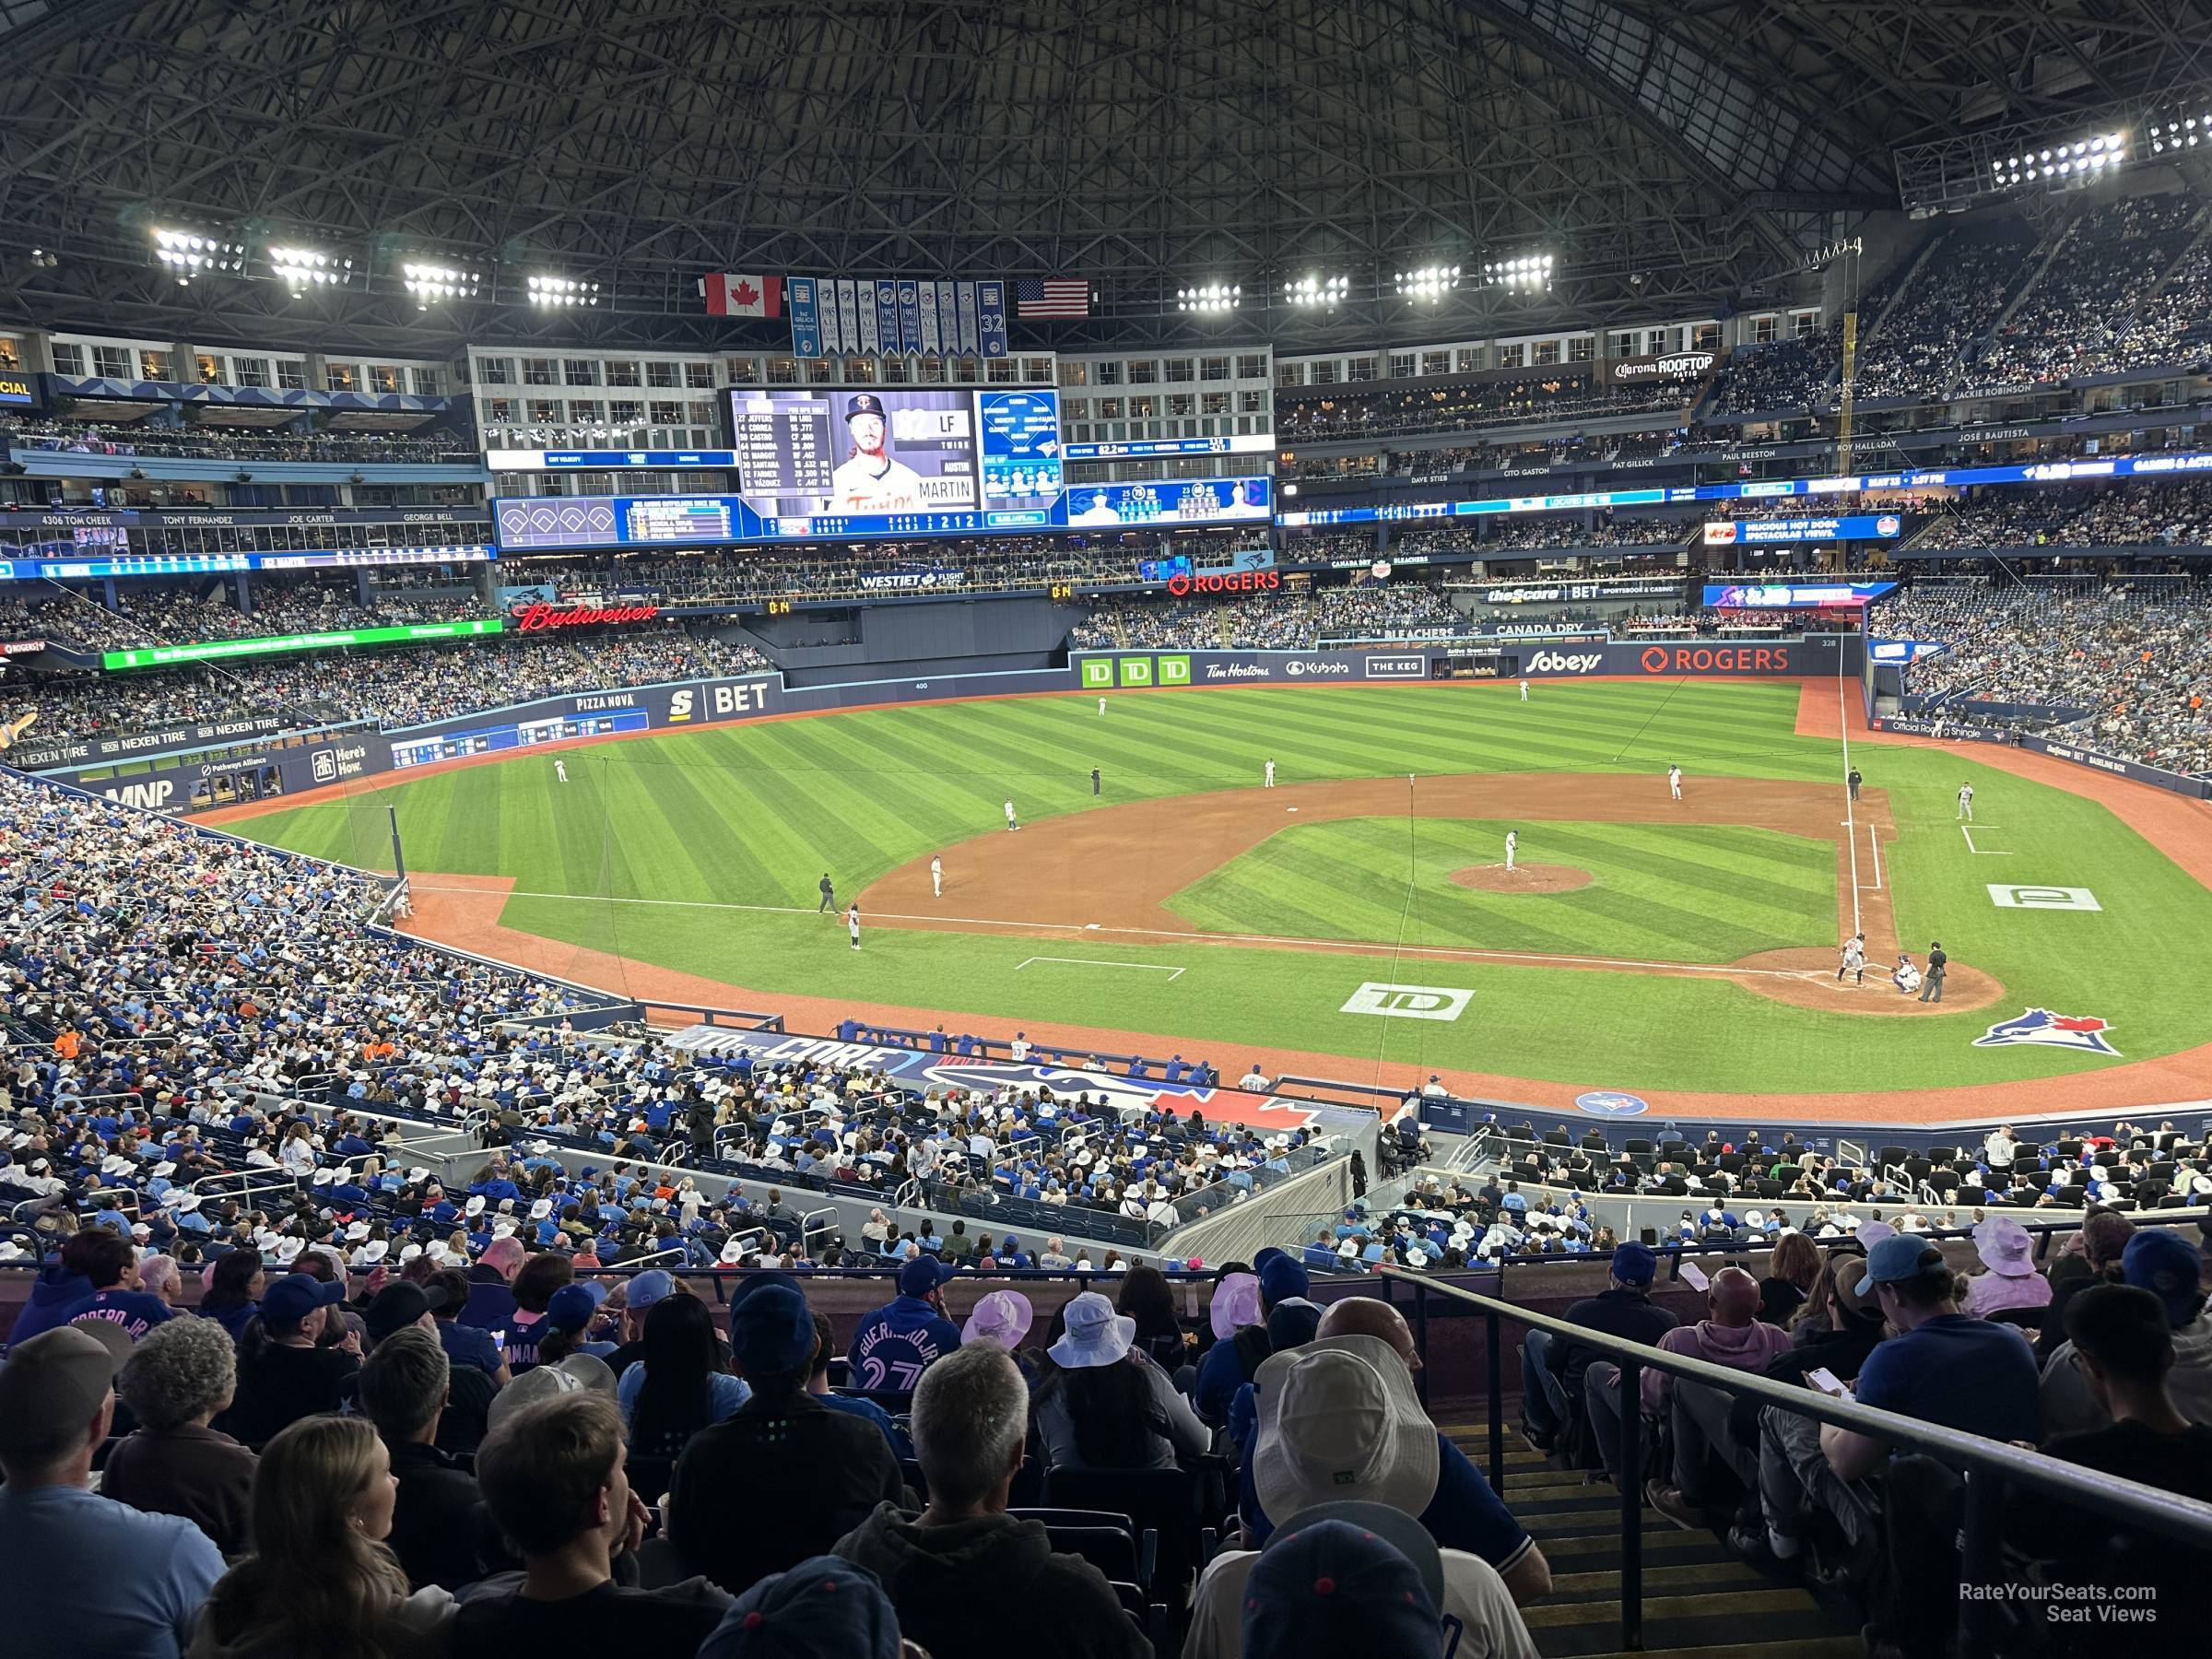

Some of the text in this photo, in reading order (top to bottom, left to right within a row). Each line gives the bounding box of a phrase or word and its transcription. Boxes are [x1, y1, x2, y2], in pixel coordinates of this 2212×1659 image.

[861, 308, 875, 318] 1991
[880, 308, 895, 318] 1992
[902, 308, 916, 318] 1993
[922, 309, 936, 319] 2015
[981, 314, 1004, 333] 32
[1615, 357, 1713, 379] Corona ROOFTOP
[1673, 371, 1698, 379] PATIO
[1954, 384, 2031, 400] JACKIE ROBINSON
[939, 416, 955, 433] LF
[1958, 429, 2029, 442] JOSÉ BAUTISTA
[940, 441, 970, 450] TWINS
[1099, 445, 1117, 455] 82.2
[1854, 441, 1898, 451] HALLADAY
[1742, 450, 1776, 459] BEESTON
[944, 462, 970, 473] AUSTIN
[1022, 466, 1034, 475] 28
[1612, 459, 1654, 469] PAT GILLICK
[1522, 467, 1550, 476] GASTON
[1410, 474, 1448, 484] DAVE STIEB
[1867, 477, 1888, 488] MAY
[919, 481, 970, 499] MARTIN
[1549, 497, 1582, 506] LOCATED
[41, 515, 112, 525] 4306 TOM CHEEK
[162, 515, 233, 525] TONY FERNANDEZ
[288, 514, 335, 524] JOE CARTER
[404, 512, 453, 522] GEORGE BELL
[941, 516, 949, 528] 2
[966, 514, 974, 527] 2
[1745, 521, 1840, 532] DELICIOUS HOT DOGS.
[1745, 529, 1835, 541] SPECTACULAR VIEWS.
[1393, 556, 1429, 564] BLEACHERS
[938, 572, 965, 582] FLIGHT
[1193, 571, 1279, 593] ROGERS
[1488, 589, 1560, 602] theScore
[1571, 586, 1600, 599] BET
[512, 604, 658, 631] Budweiser
[1384, 623, 1585, 640] BLEACHERS CANADA DRY
[12, 643, 38, 653] ROGERS
[1372, 662, 1418, 671] THE KEG
[1525, 651, 1602, 673] Sobeys
[1676, 649, 1789, 672] ROGERS
[1085, 665, 1110, 682] TD
[1123, 663, 1148, 680] TD
[1161, 661, 1186, 678] TD
[1206, 663, 1270, 678] Tim Hortons
[1306, 663, 1349, 675] Kubota
[576, 694, 633, 712] PIZZA NOVA
[670, 683, 768, 715] S BET
[216, 718, 280, 735] NEXEN TIRE
[1892, 722, 1919, 732] Official
[1951, 727, 1982, 738] Shingle
[122, 731, 186, 750] NEXEN TIRE
[21, 745, 89, 767] NEXEN TIRE
[336, 745, 366, 762] Here's
[212, 757, 267, 772] Pathways Alliance
[338, 760, 363, 776] How.
[2074, 751, 2085, 762] BET
[2088, 756, 2113, 770] BASELINE
[2114, 762, 2126, 773] BOX
[104, 780, 173, 809] MNP
[171, 806, 183, 815] You
[1369, 988, 1454, 1012] TD
[691, 1030, 898, 1072] TO THE CORE
[862, 1356, 924, 1390] 27
